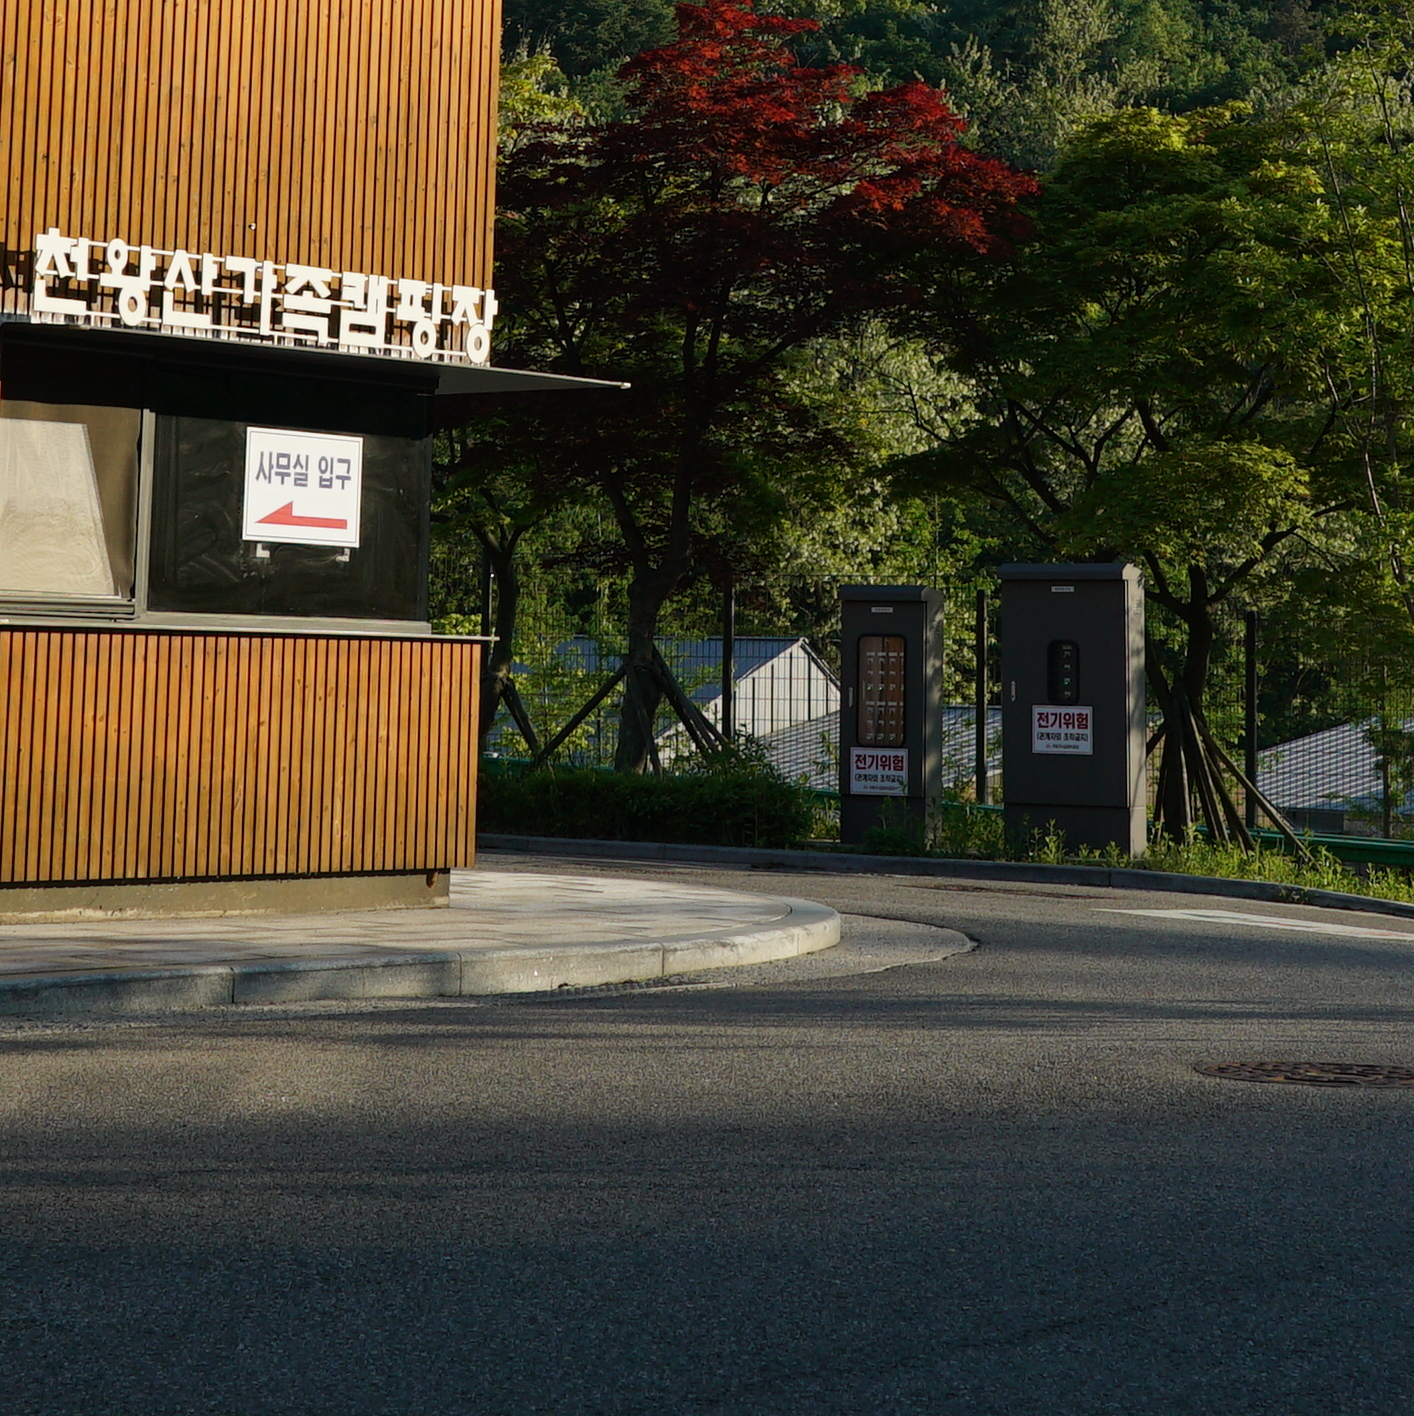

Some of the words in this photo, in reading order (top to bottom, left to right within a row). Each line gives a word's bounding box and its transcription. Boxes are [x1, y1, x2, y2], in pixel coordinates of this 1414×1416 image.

[34, 227, 498, 364] 천왕산가족캠핑장
[255, 451, 309, 488] 사무실
[318, 455, 352, 490] 입구
[1037, 712, 1089, 730] 전기위험
[854, 754, 904, 771] 전기위험
